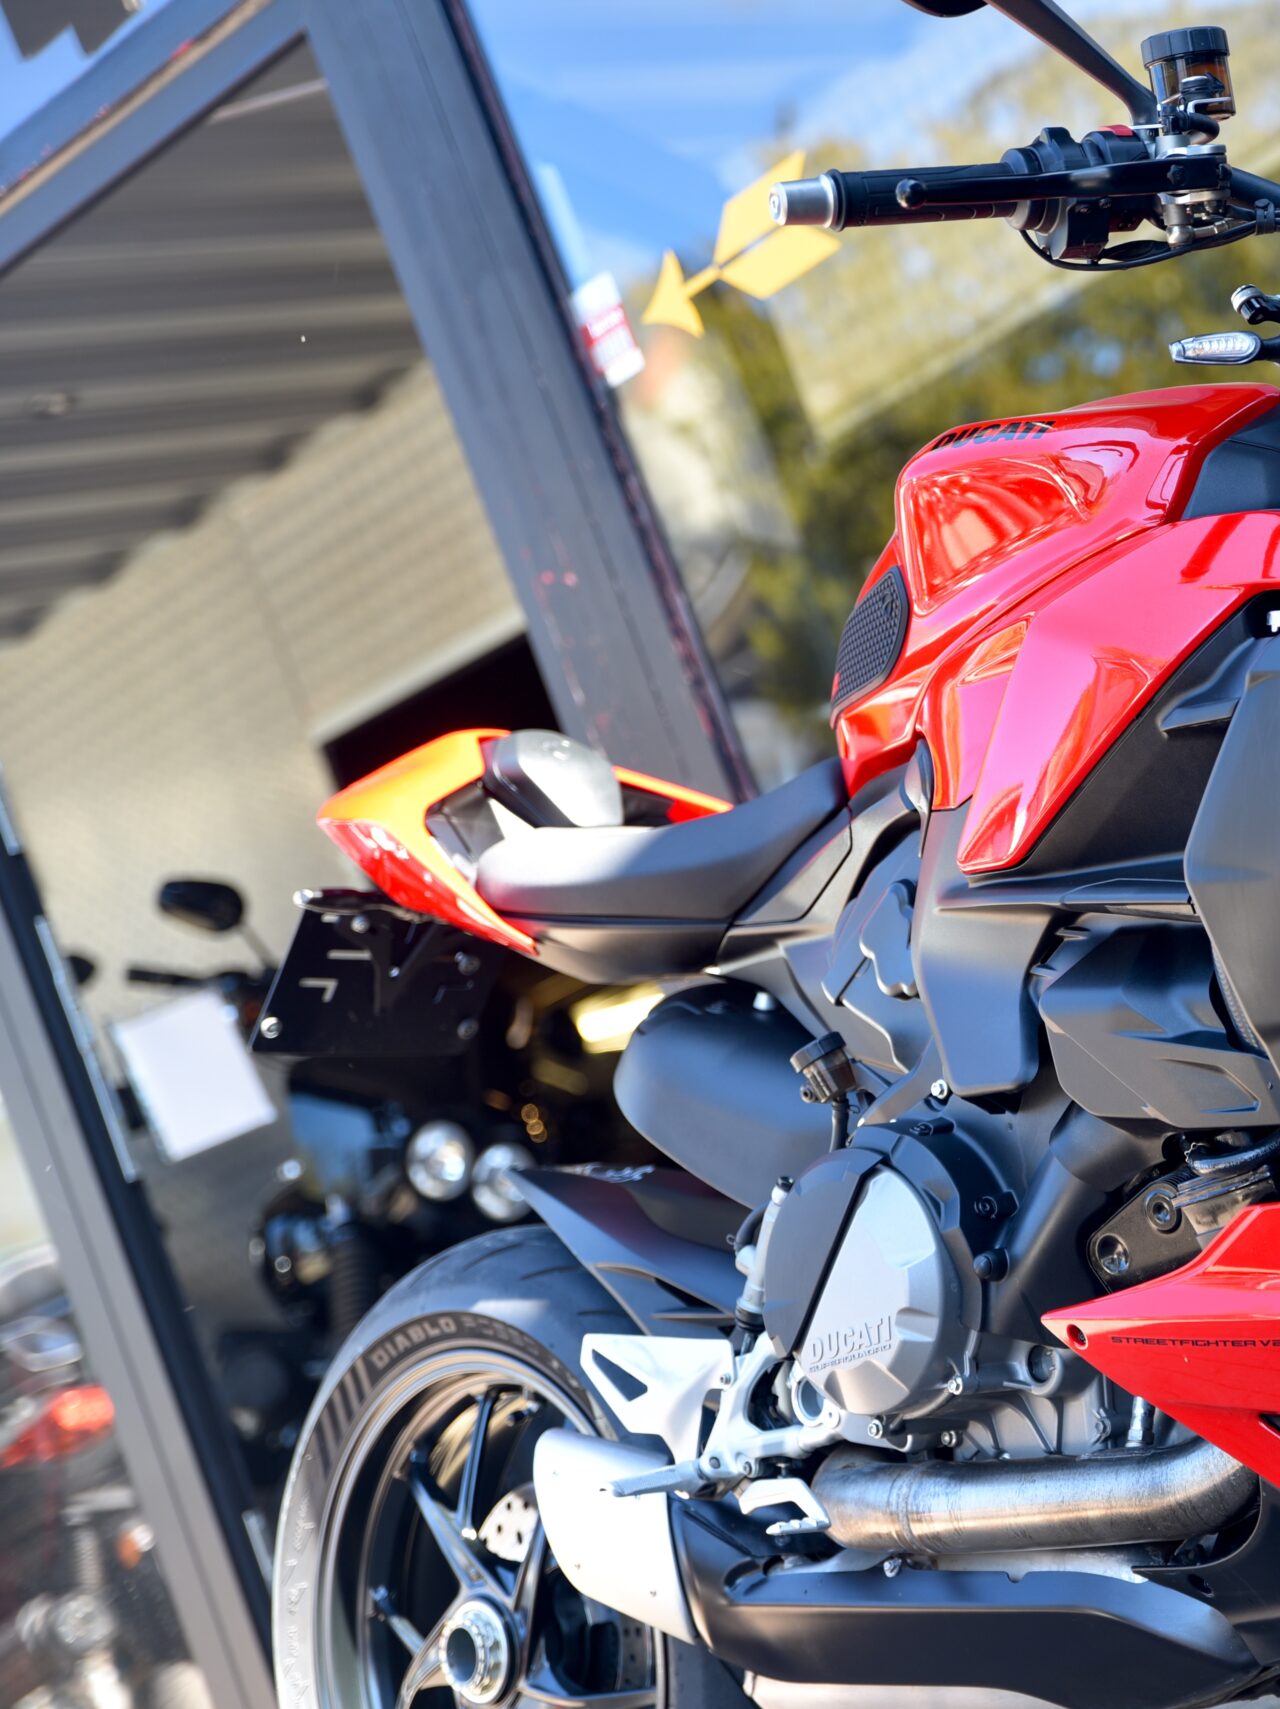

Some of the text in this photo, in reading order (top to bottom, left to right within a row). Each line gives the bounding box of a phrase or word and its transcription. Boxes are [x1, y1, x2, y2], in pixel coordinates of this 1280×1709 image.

[931, 421, 1056, 451] DUCATI
[370, 1317, 458, 1369] DIABLO
[811, 1315, 892, 1365] DUCATI
[1110, 1335, 1257, 1347] STREETFIGHTER
